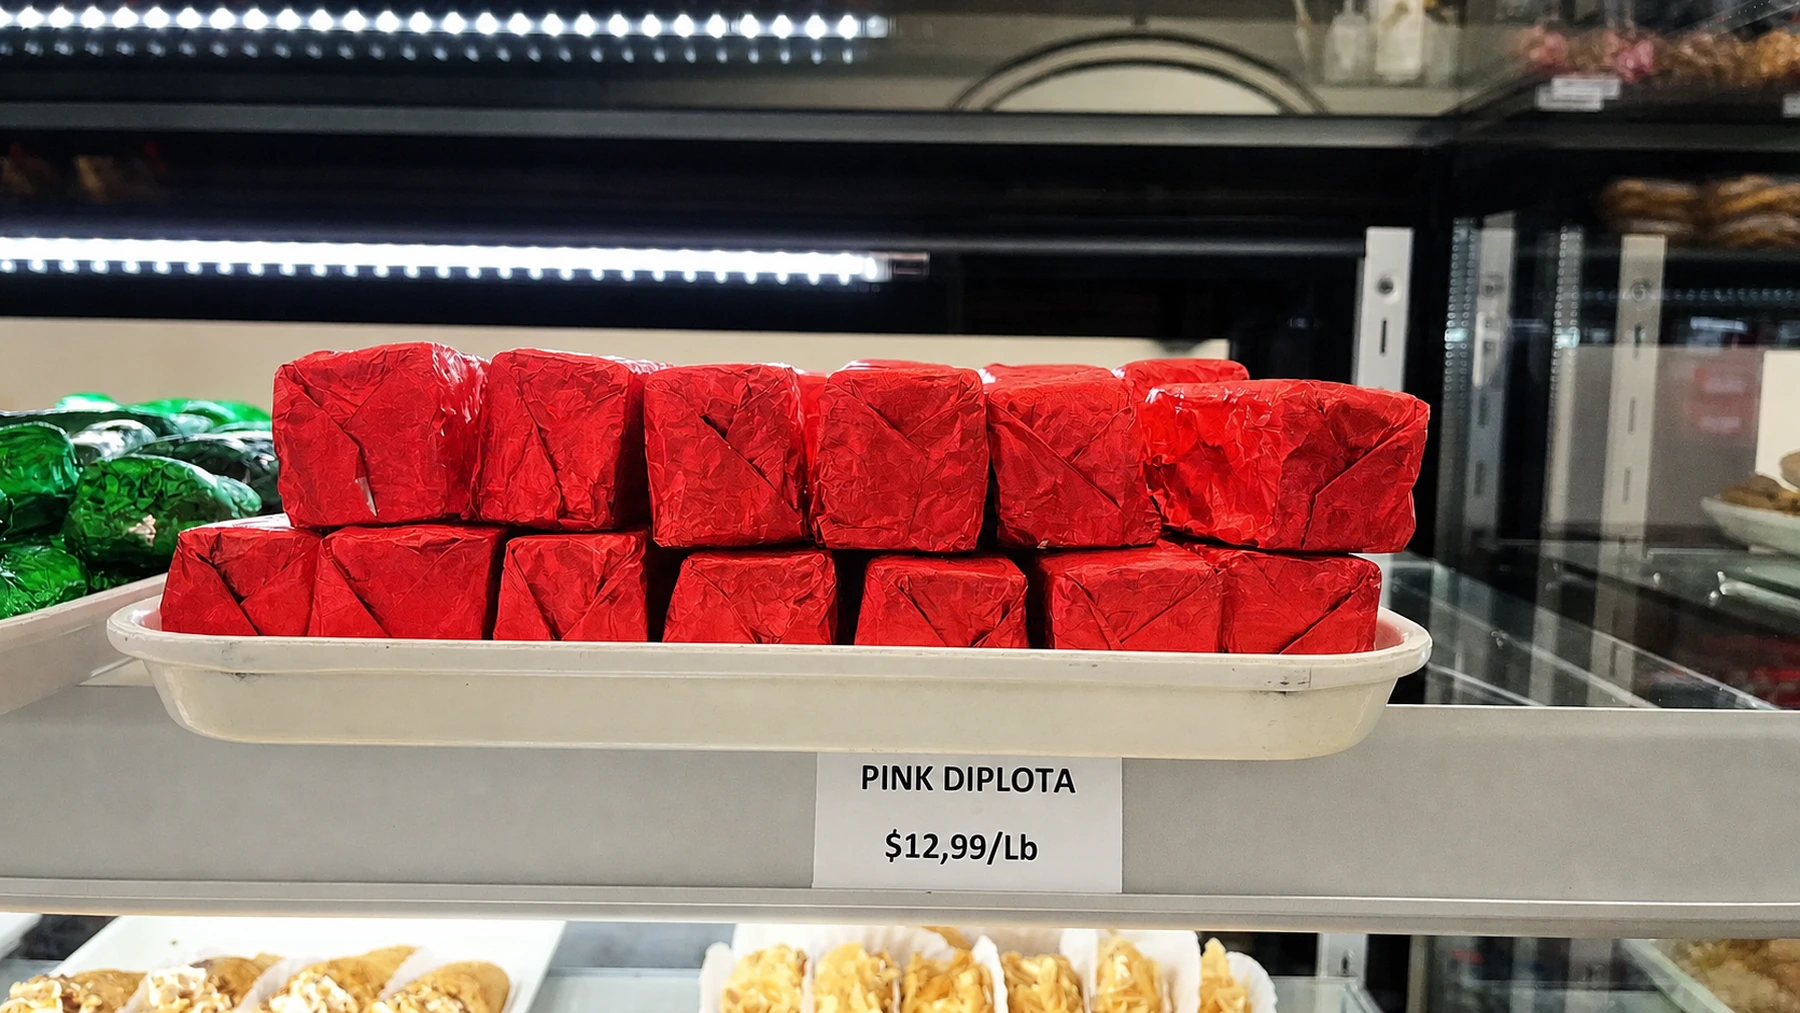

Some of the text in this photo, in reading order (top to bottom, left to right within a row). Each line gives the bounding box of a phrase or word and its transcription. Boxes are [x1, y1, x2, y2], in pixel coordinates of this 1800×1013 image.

[861, 764, 1076, 794] PINK DIPLOTA
[885, 828, 1038, 865] $12,99/Lb
